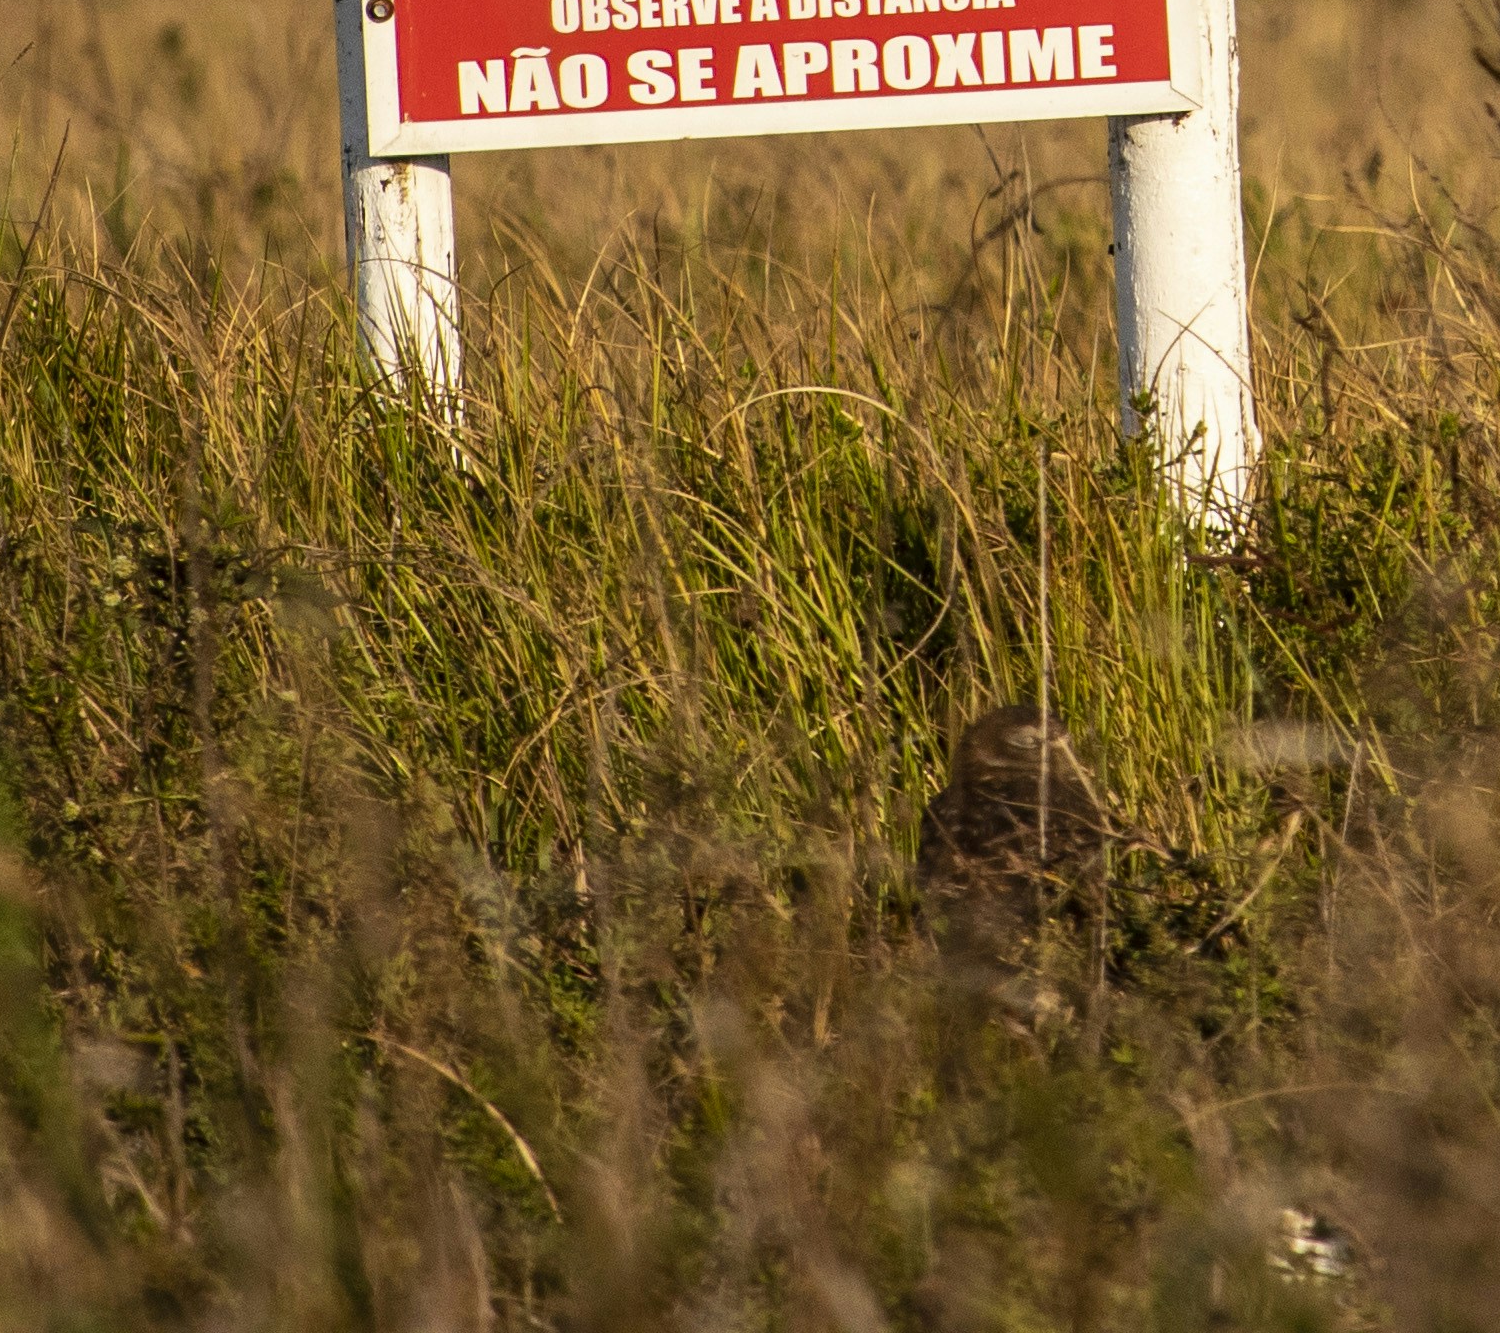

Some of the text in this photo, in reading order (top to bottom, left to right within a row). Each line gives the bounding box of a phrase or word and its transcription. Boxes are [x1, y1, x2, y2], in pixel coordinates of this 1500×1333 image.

[458, 24, 1118, 115] NÃO SE APROXIME
